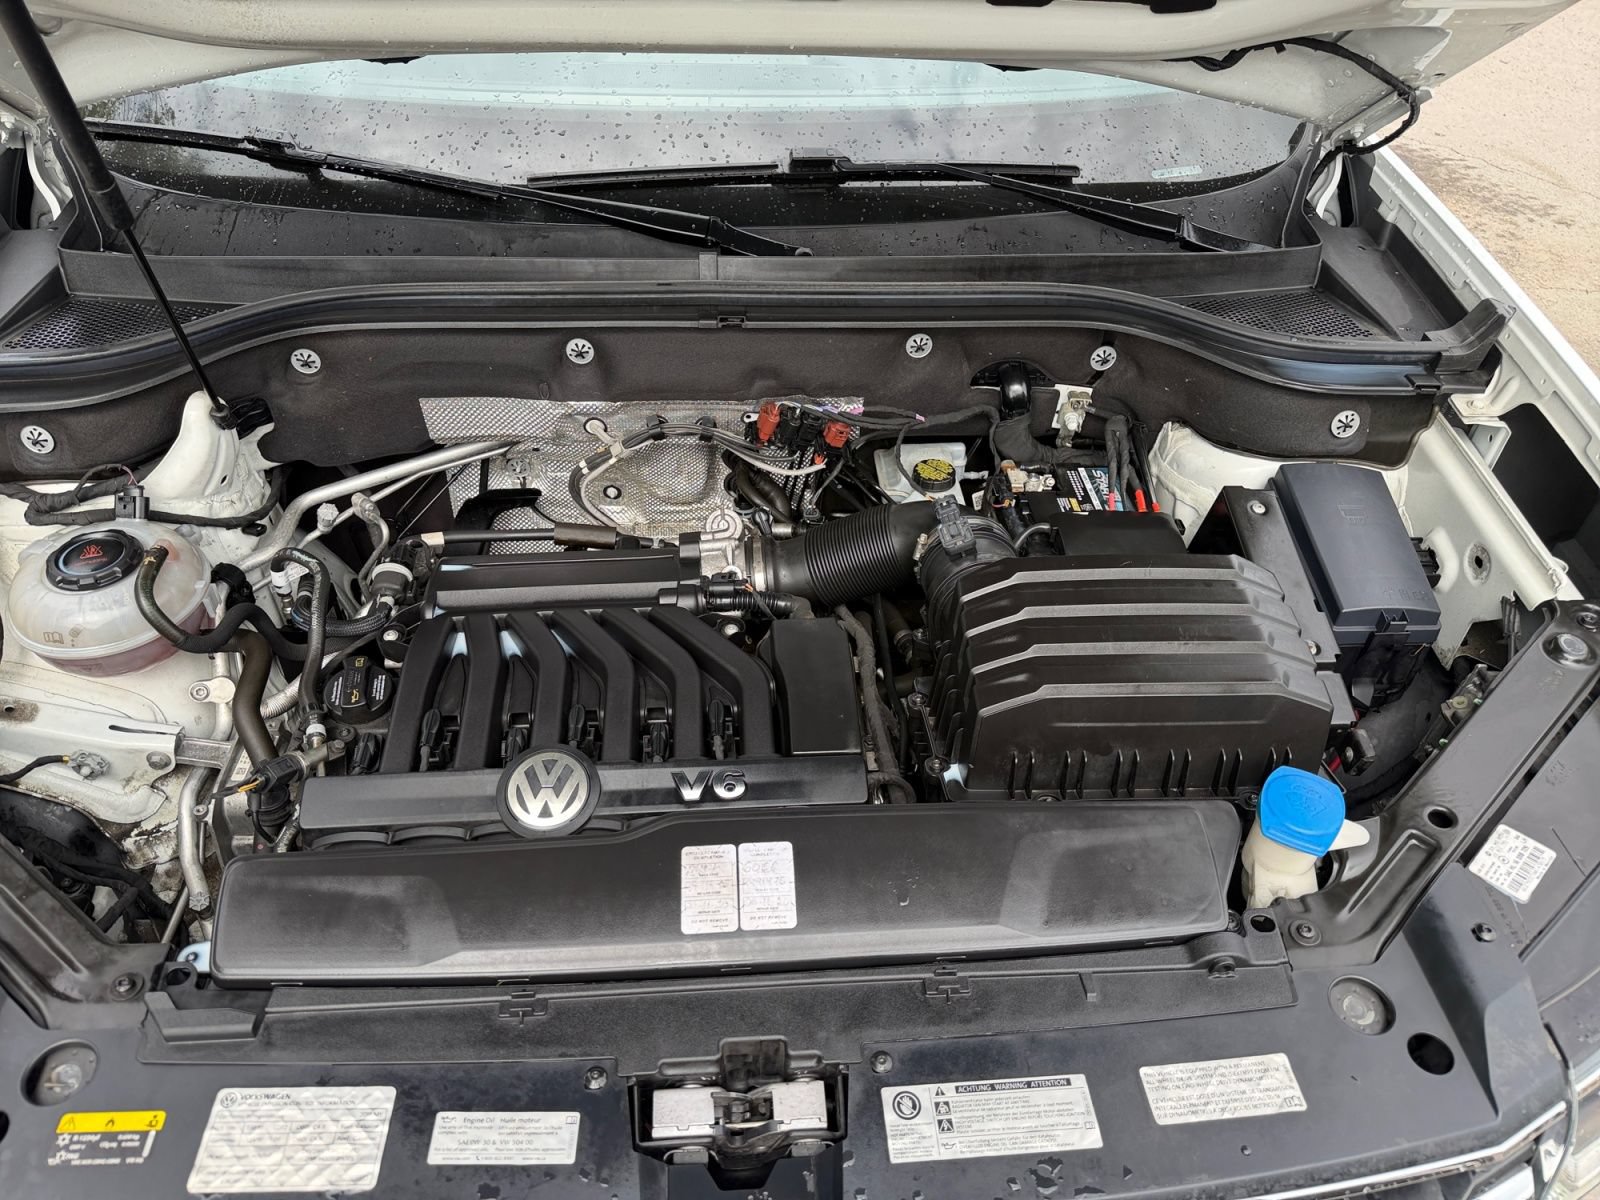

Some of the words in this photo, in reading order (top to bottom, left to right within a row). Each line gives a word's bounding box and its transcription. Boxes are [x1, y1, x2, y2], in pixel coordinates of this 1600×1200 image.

[671, 768, 746, 801] V6
[958, 1084, 991, 1093] ACHTUNG
[994, 1082, 1027, 1091] WARNING
[1030, 1079, 1067, 1088] ATTENTION
[463, 1116, 484, 1125] Engine
